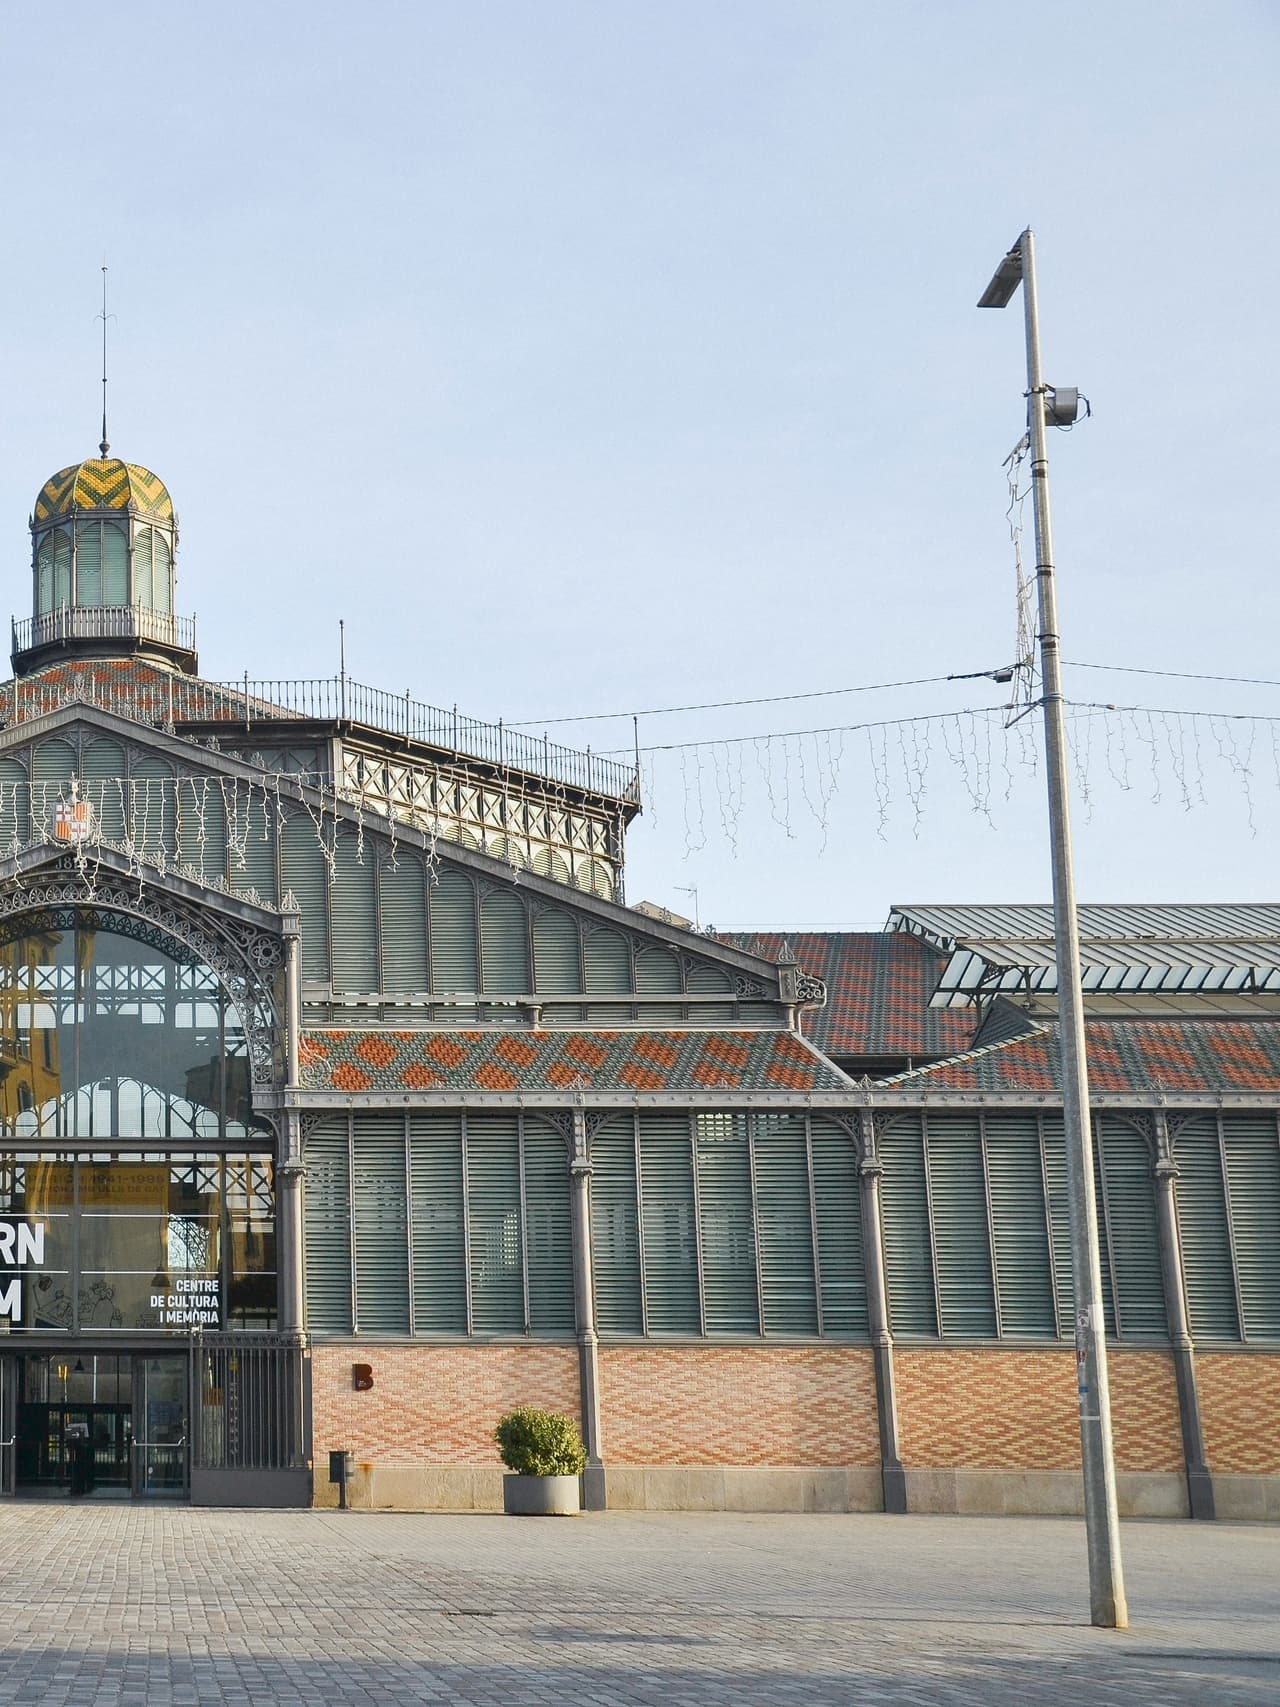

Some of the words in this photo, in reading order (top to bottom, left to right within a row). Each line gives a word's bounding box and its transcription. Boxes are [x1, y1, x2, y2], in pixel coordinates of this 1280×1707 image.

[176, 1280, 219, 1292] CENTRE
[150, 1295, 165, 1308] DE
[167, 1295, 219, 1308] CULTURA
[160, 1310, 163, 1323] I
[166, 1308, 219, 1323] MEMÒRIA
